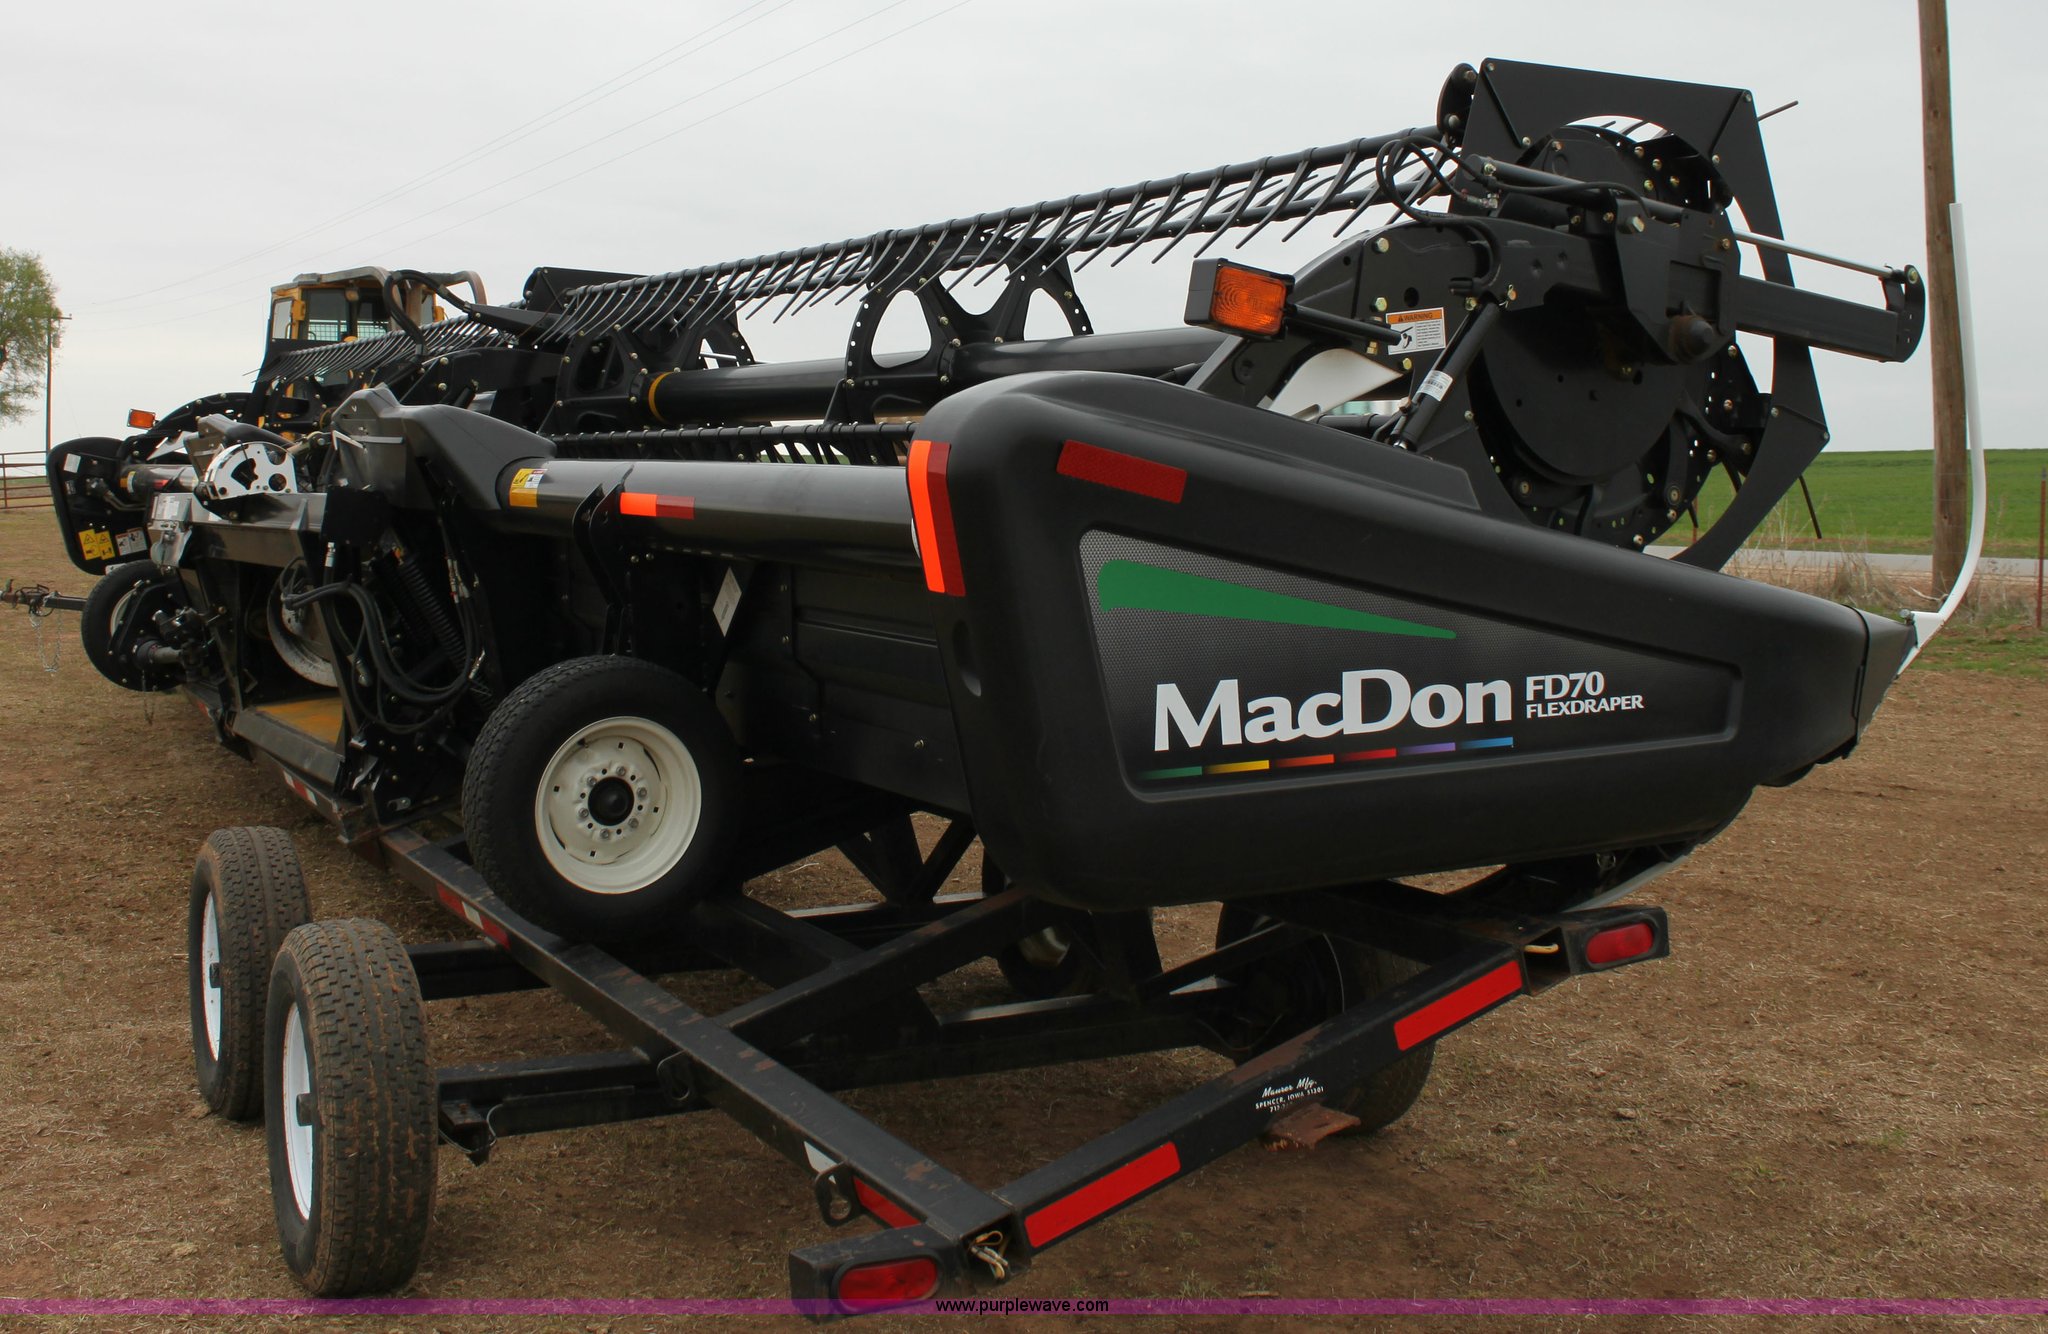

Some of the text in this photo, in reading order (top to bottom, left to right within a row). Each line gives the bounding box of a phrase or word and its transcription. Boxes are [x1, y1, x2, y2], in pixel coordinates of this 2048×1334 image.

[1404, 312, 1433, 321] WARNING
[1526, 671, 1605, 701] FD70
[1154, 668, 1513, 752] MacDon
[1526, 694, 1645, 719] FLEXDRAPER
[1287, 1092, 1304, 1100] IOWA
